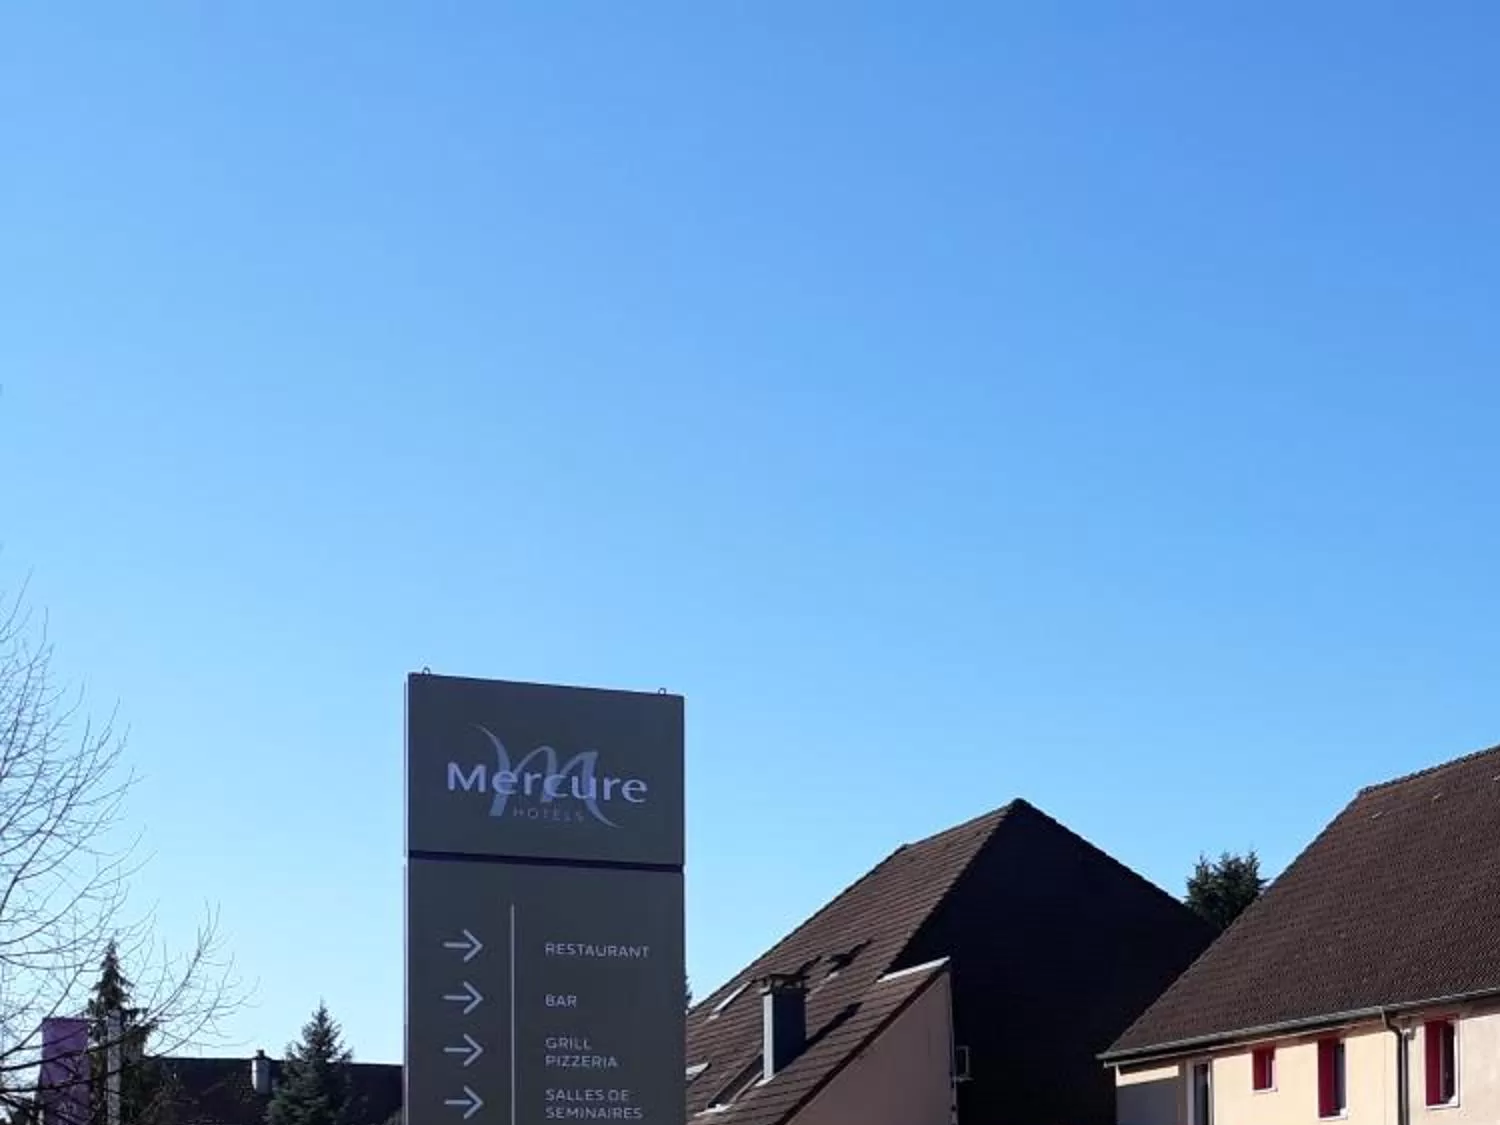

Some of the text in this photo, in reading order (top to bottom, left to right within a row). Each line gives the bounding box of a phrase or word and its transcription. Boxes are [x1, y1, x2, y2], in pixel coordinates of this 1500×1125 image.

[447, 761, 648, 803] Mercure
[513, 806, 585, 823] HOTELS
[545, 943, 649, 958] RESTAURANT
[545, 994, 577, 1008] BAR
[545, 1037, 592, 1050] GRILL
[545, 1055, 618, 1069] PIZZERIA
[545, 1089, 604, 1101] SALLES
[545, 1107, 643, 1119] SEMINAIRES
